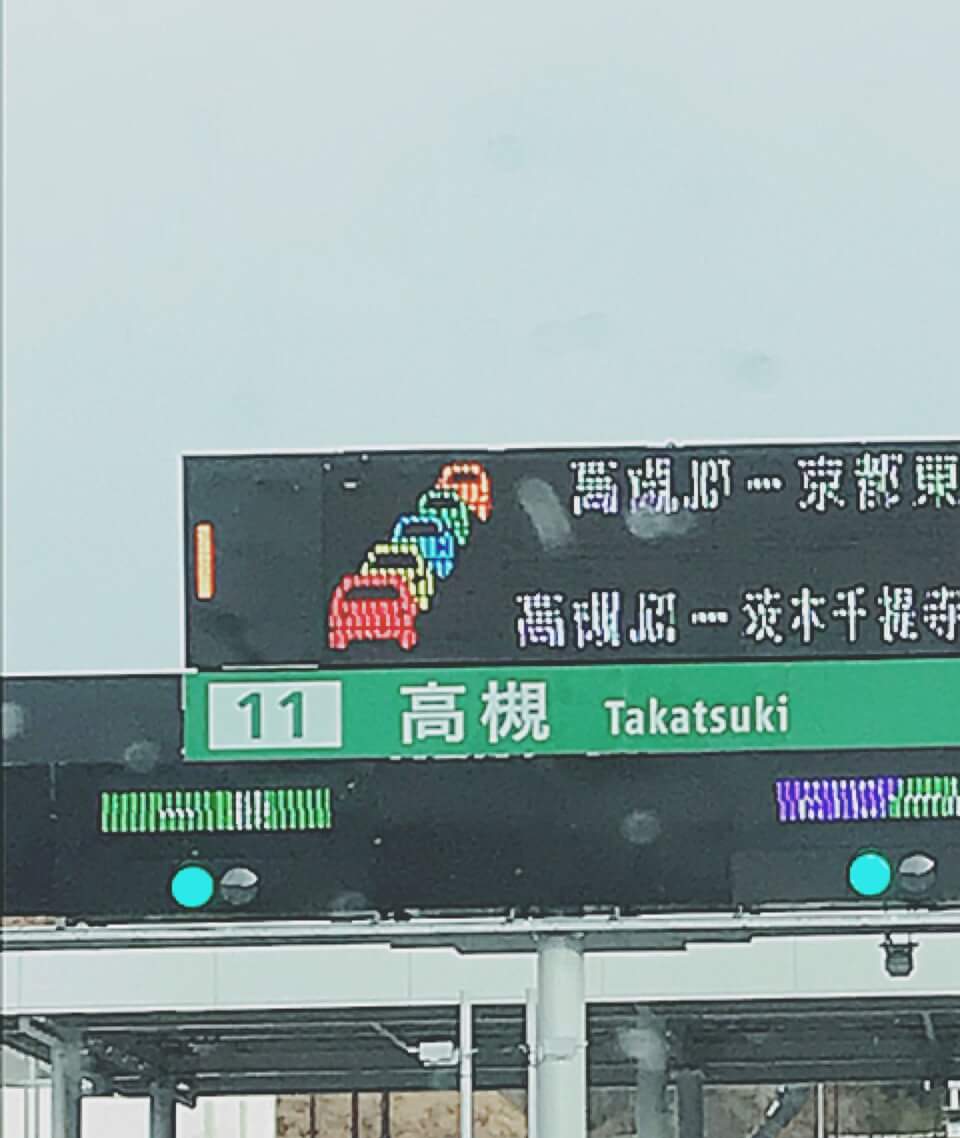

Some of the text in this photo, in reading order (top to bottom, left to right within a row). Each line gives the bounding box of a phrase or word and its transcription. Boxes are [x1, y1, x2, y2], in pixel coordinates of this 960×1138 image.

[236, 690, 306, 741] 11
[400, 680, 550, 745] 高槻
[604, 694, 790, 737] Takatsuki
